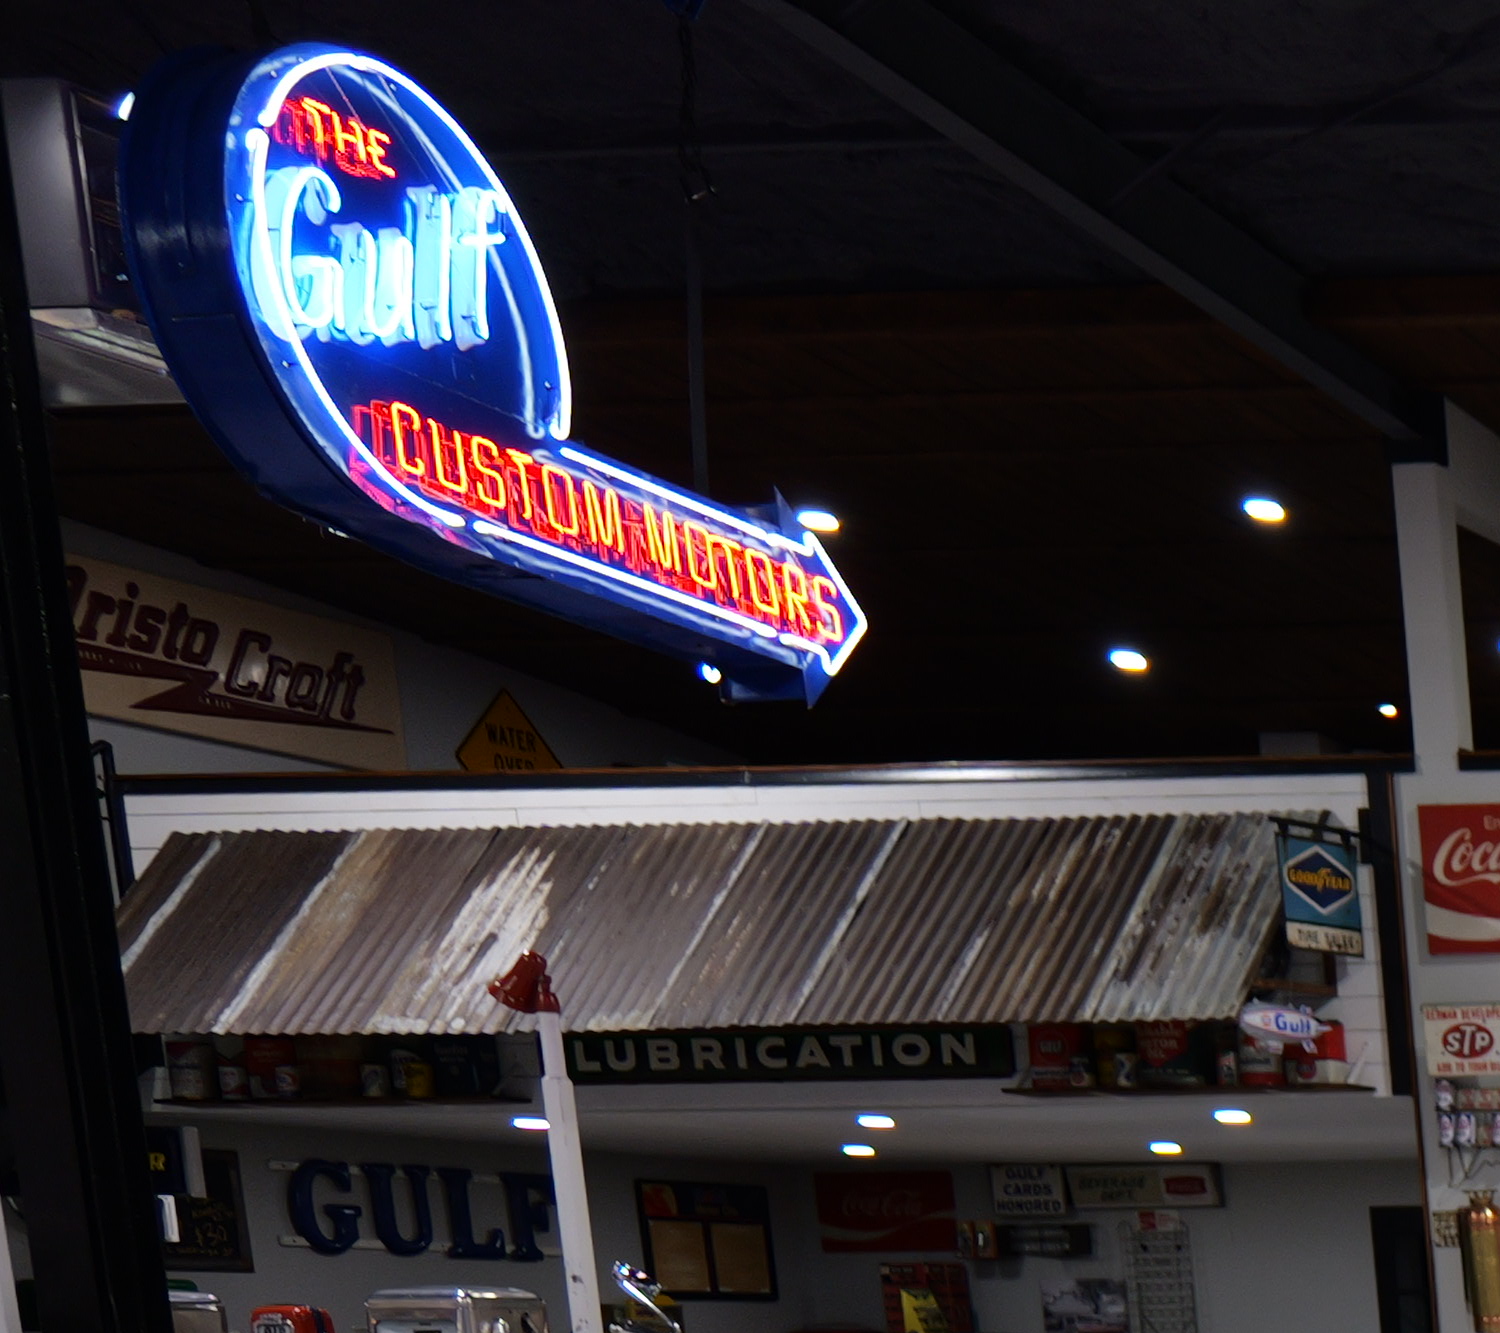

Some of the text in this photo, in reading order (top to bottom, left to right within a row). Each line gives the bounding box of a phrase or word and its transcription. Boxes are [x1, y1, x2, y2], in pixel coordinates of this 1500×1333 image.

[283, 97, 395, 179] THE
[248, 167, 509, 350] Gulf
[372, 402, 842, 644] CUSTOM MOTORS
[225, 627, 367, 721] Craft
[484, 721, 537, 754] WATER
[1275, 1012, 1312, 1034] Gulf
[1445, 1025, 1492, 1057] STP
[573, 1031, 978, 1073] LUBRICATION
[288, 1158, 557, 1262] GULF
[996, 1199, 1062, 1214] HONORED
[1002, 1183, 1053, 1197] CARDS
